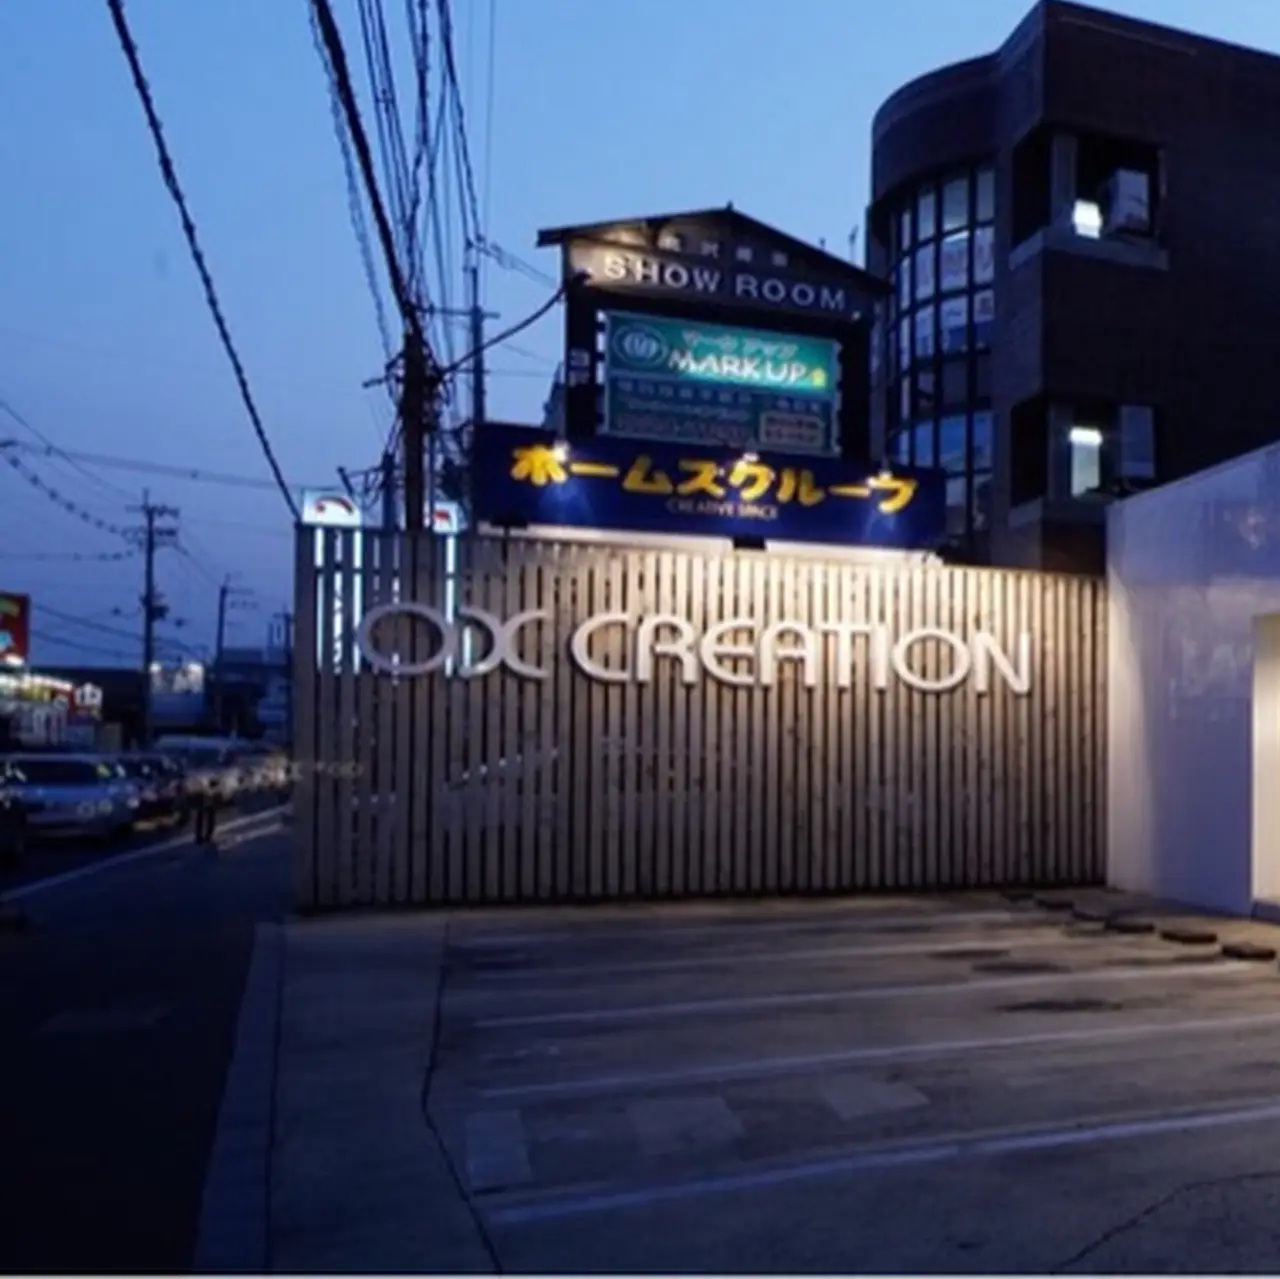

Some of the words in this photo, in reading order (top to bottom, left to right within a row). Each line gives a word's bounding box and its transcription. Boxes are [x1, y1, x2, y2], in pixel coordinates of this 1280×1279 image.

[603, 254, 721, 294] SHOW
[735, 273, 846, 311] ROOM
[667, 347, 760, 380] MARK
[764, 359, 807, 385] UP
[356, 601, 550, 681] OX
[571, 609, 1031, 696] CREATION
